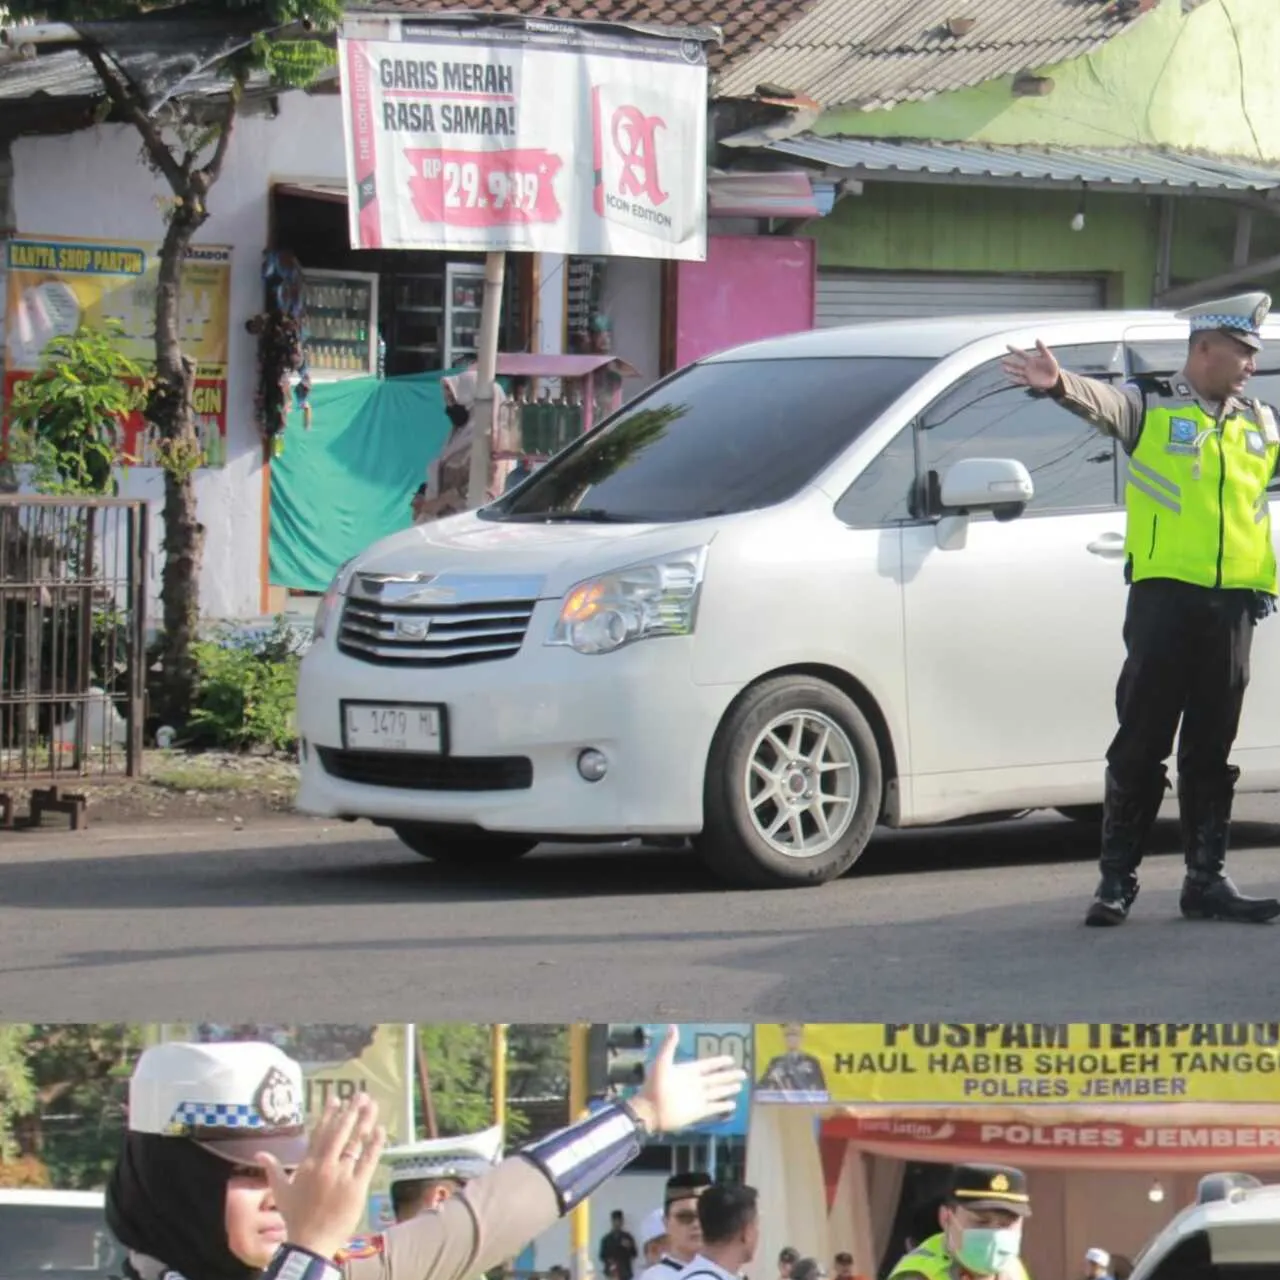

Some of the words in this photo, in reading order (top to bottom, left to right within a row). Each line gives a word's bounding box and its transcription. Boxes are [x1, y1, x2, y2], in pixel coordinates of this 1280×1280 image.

[380, 59, 439, 90] GARIS
[442, 62, 514, 93] MERAH
[383, 102, 436, 133] RASA
[440, 104, 517, 136] SAMAA!
[606, 193, 631, 213] ICON
[631, 204, 673, 229] EDITION
[59, 248, 91, 271] SHOP
[834, 1053, 916, 1074] HAUL
[928, 1053, 1023, 1074] HABIB
[1035, 1053, 1159, 1075] SHOLEH
[963, 1078, 1069, 1097] POLRES
[1080, 1077, 1187, 1096] JEMBER
[980, 1124, 1122, 1147] POLRES
